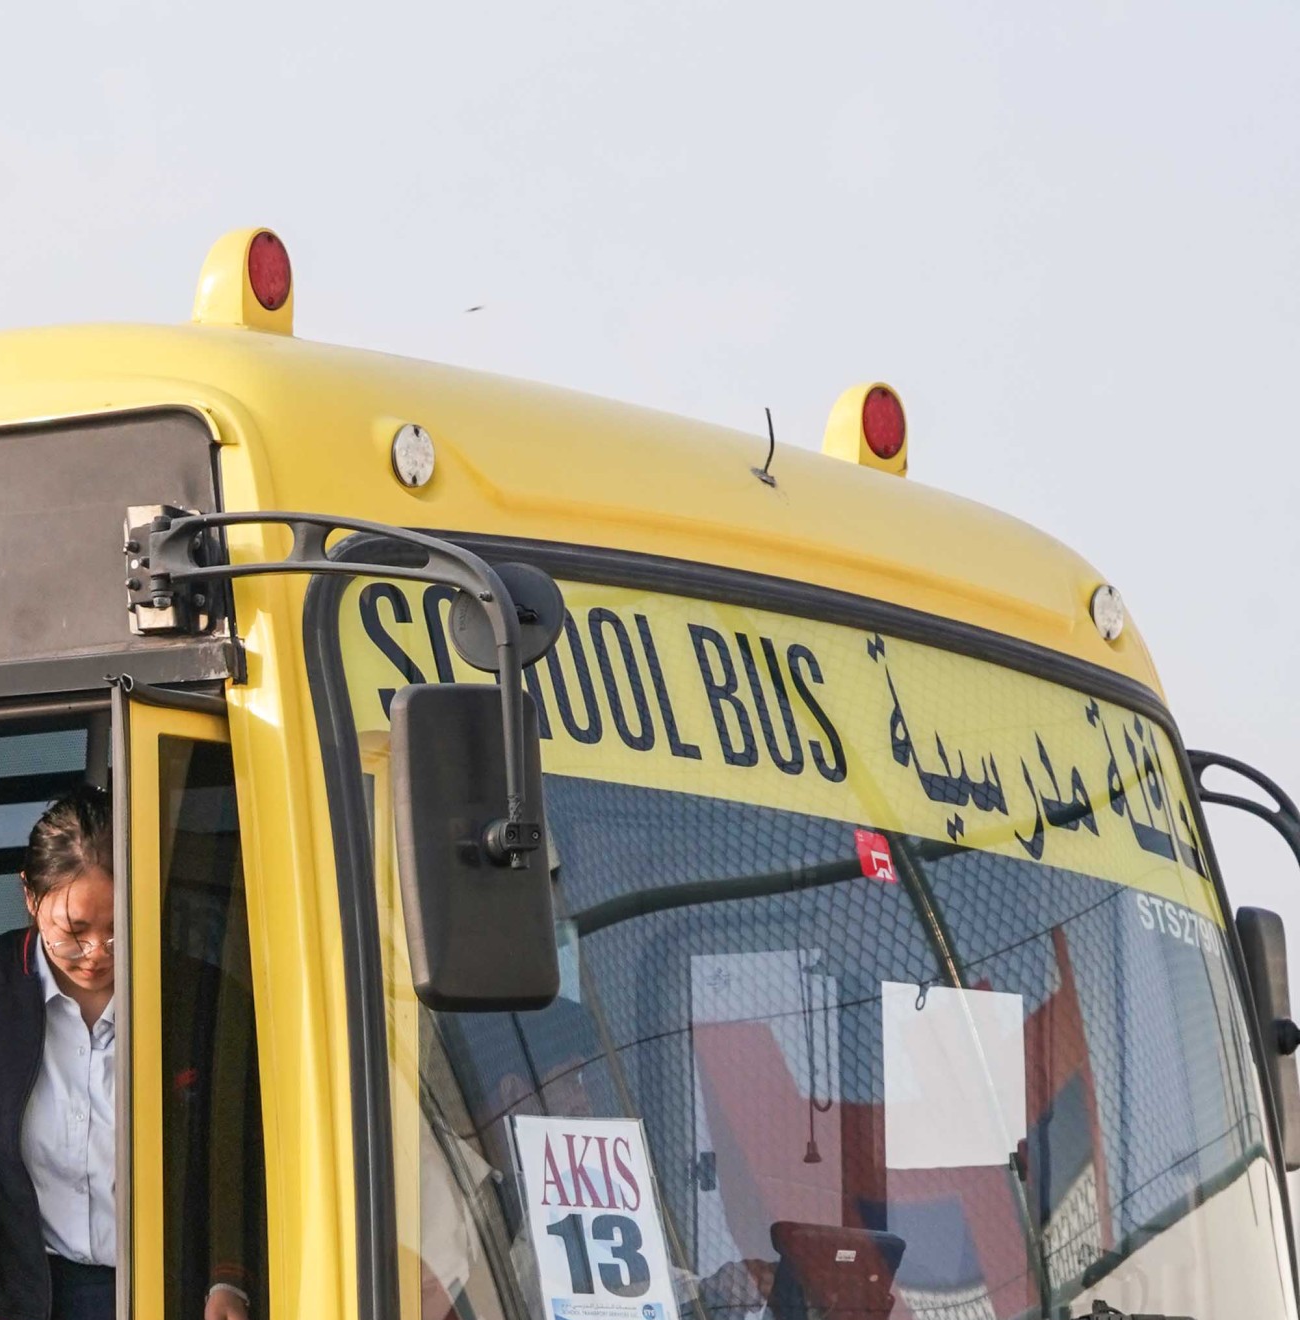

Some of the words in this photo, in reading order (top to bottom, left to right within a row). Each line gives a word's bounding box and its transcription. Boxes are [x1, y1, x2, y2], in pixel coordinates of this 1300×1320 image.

[359, 582, 702, 760] SOOL
[687, 623, 847, 783] BUS
[866, 632, 1100, 861] مدرسية
[541, 1131, 641, 1211] AKIS
[546, 1213, 651, 1298] 13
